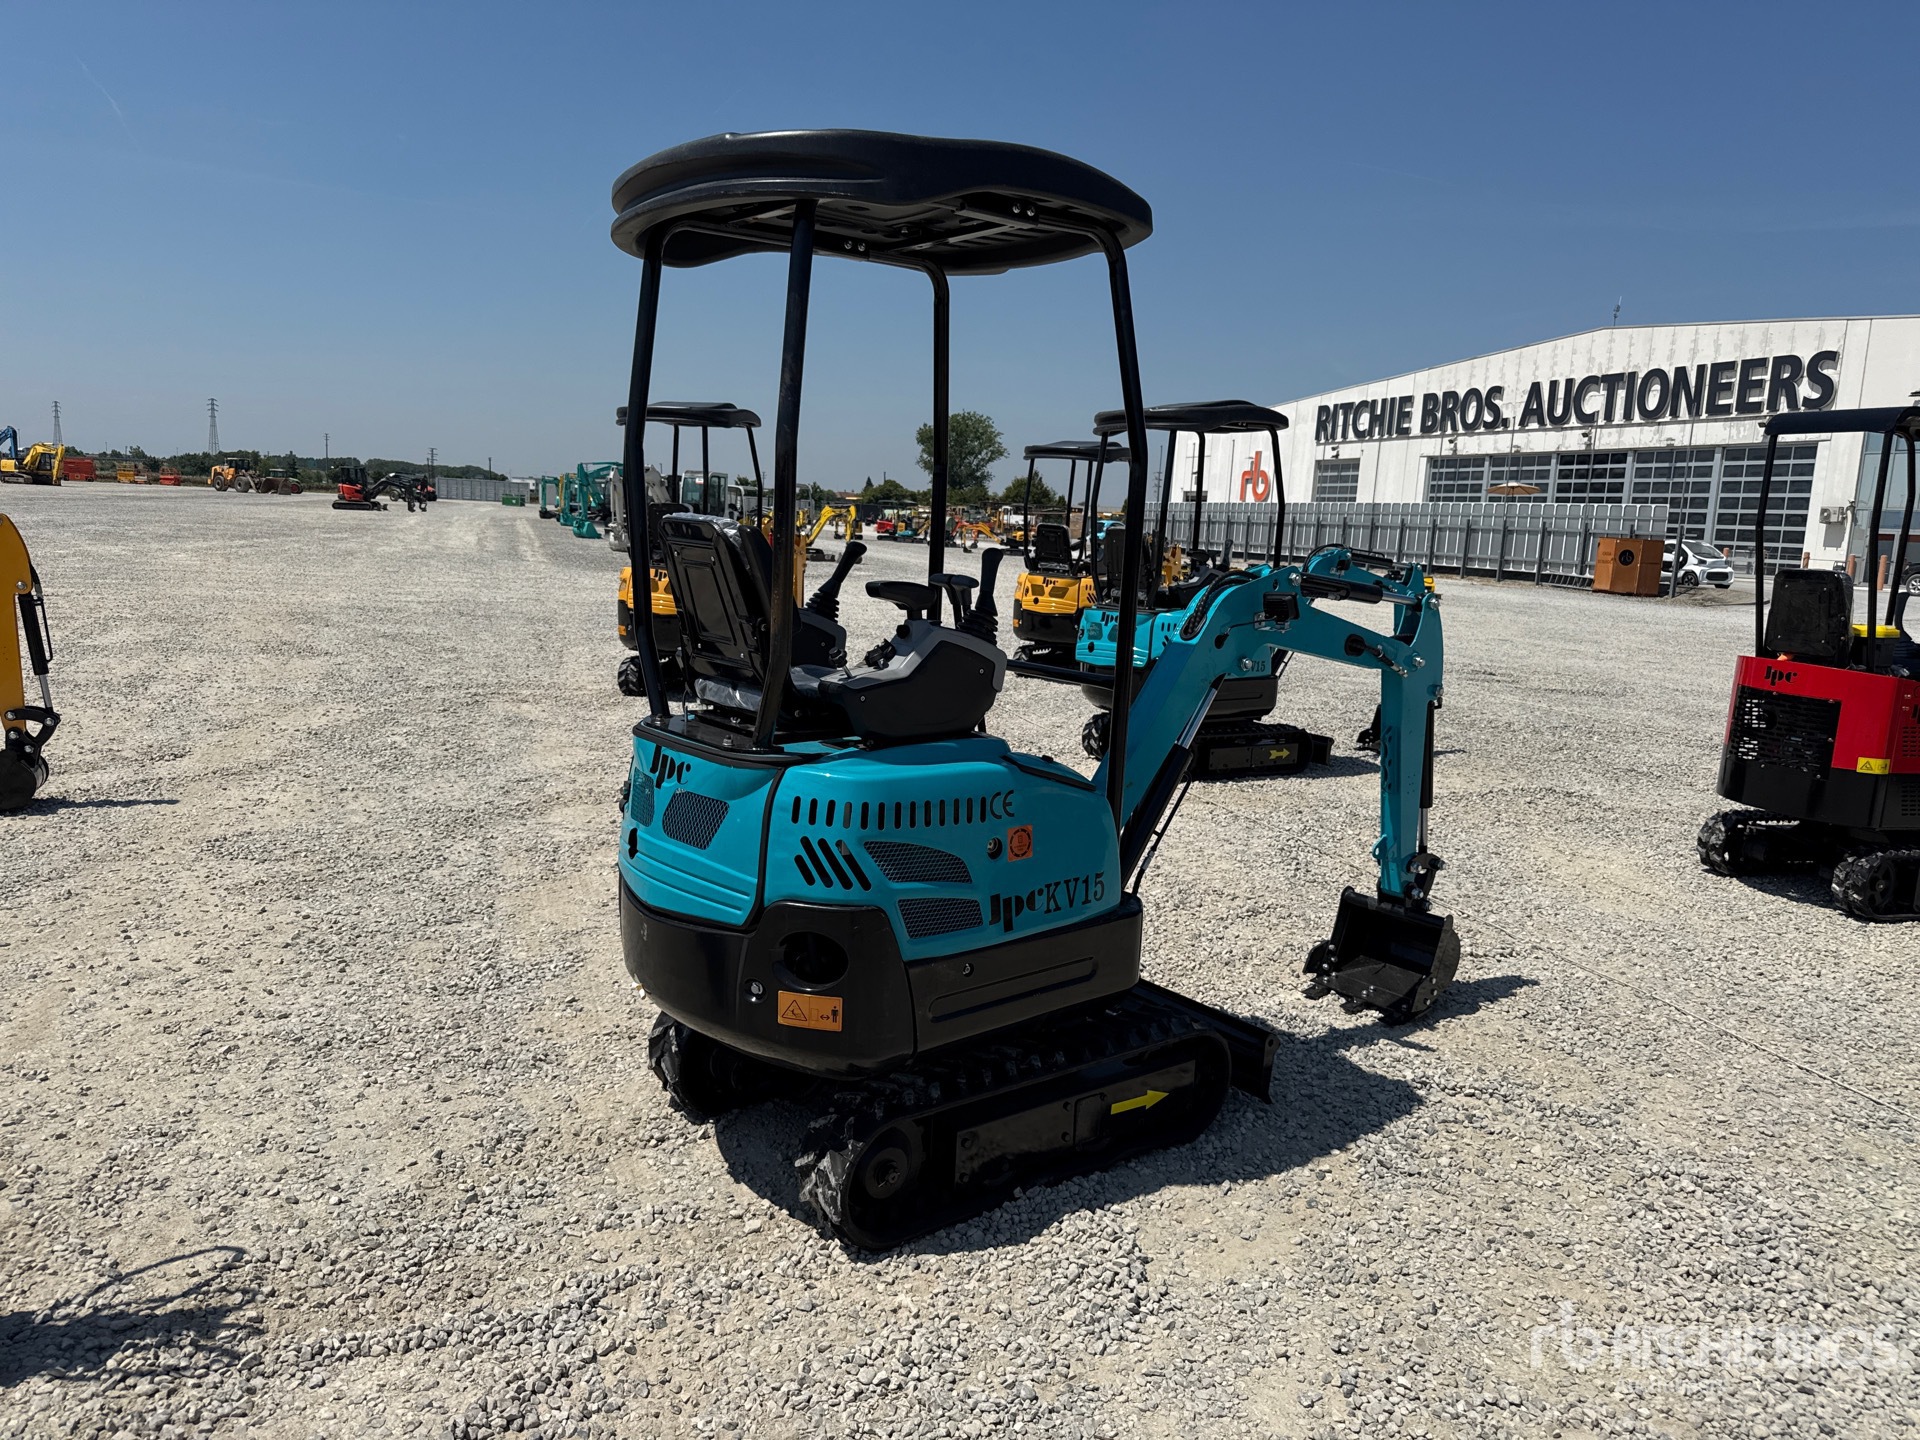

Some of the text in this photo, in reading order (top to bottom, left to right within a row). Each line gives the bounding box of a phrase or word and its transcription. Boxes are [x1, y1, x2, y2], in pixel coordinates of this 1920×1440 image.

[1315, 350, 1840, 441] RITCHIE BROS. AUCTIONEERS
[1239, 450, 1271, 503] rb
[989, 789, 1015, 820] CE
